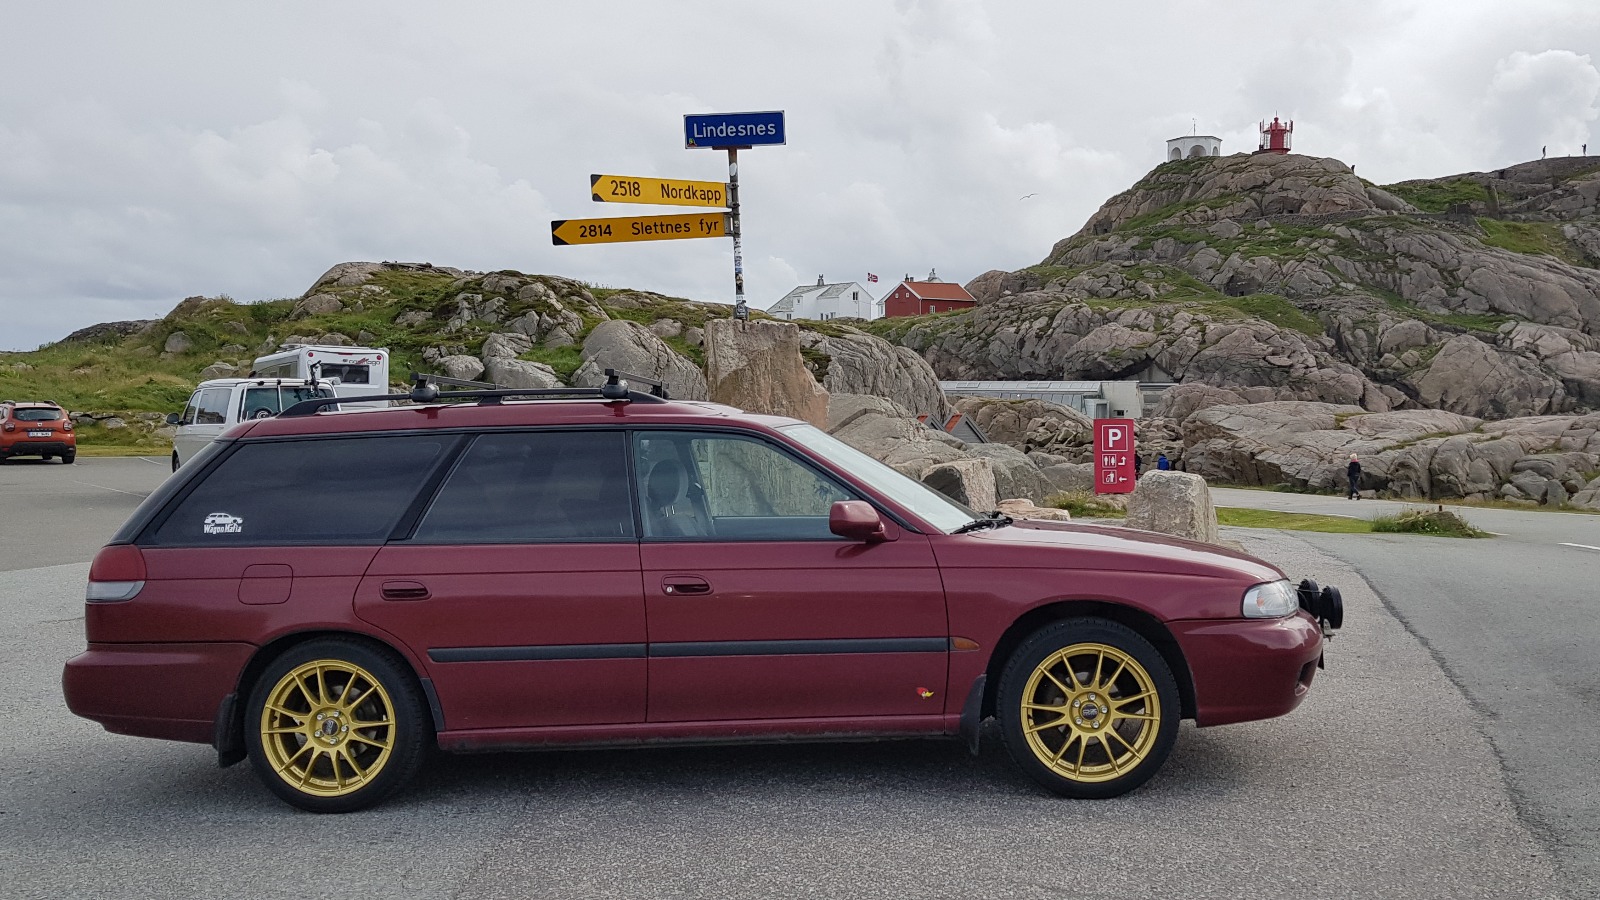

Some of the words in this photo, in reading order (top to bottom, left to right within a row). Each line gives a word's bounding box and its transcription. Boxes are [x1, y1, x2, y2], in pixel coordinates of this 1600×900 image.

[693, 121, 776, 138] Lindesnes
[610, 180, 641, 197] 2518
[660, 183, 722, 204] Nordkapp
[579, 224, 612, 238] 2814
[631, 221, 691, 236] Slettnes
[698, 218, 719, 234] fyr
[1108, 428, 1122, 448] P
[203, 524, 225, 534] Wagon
[225, 523, 242, 533] Mafia
